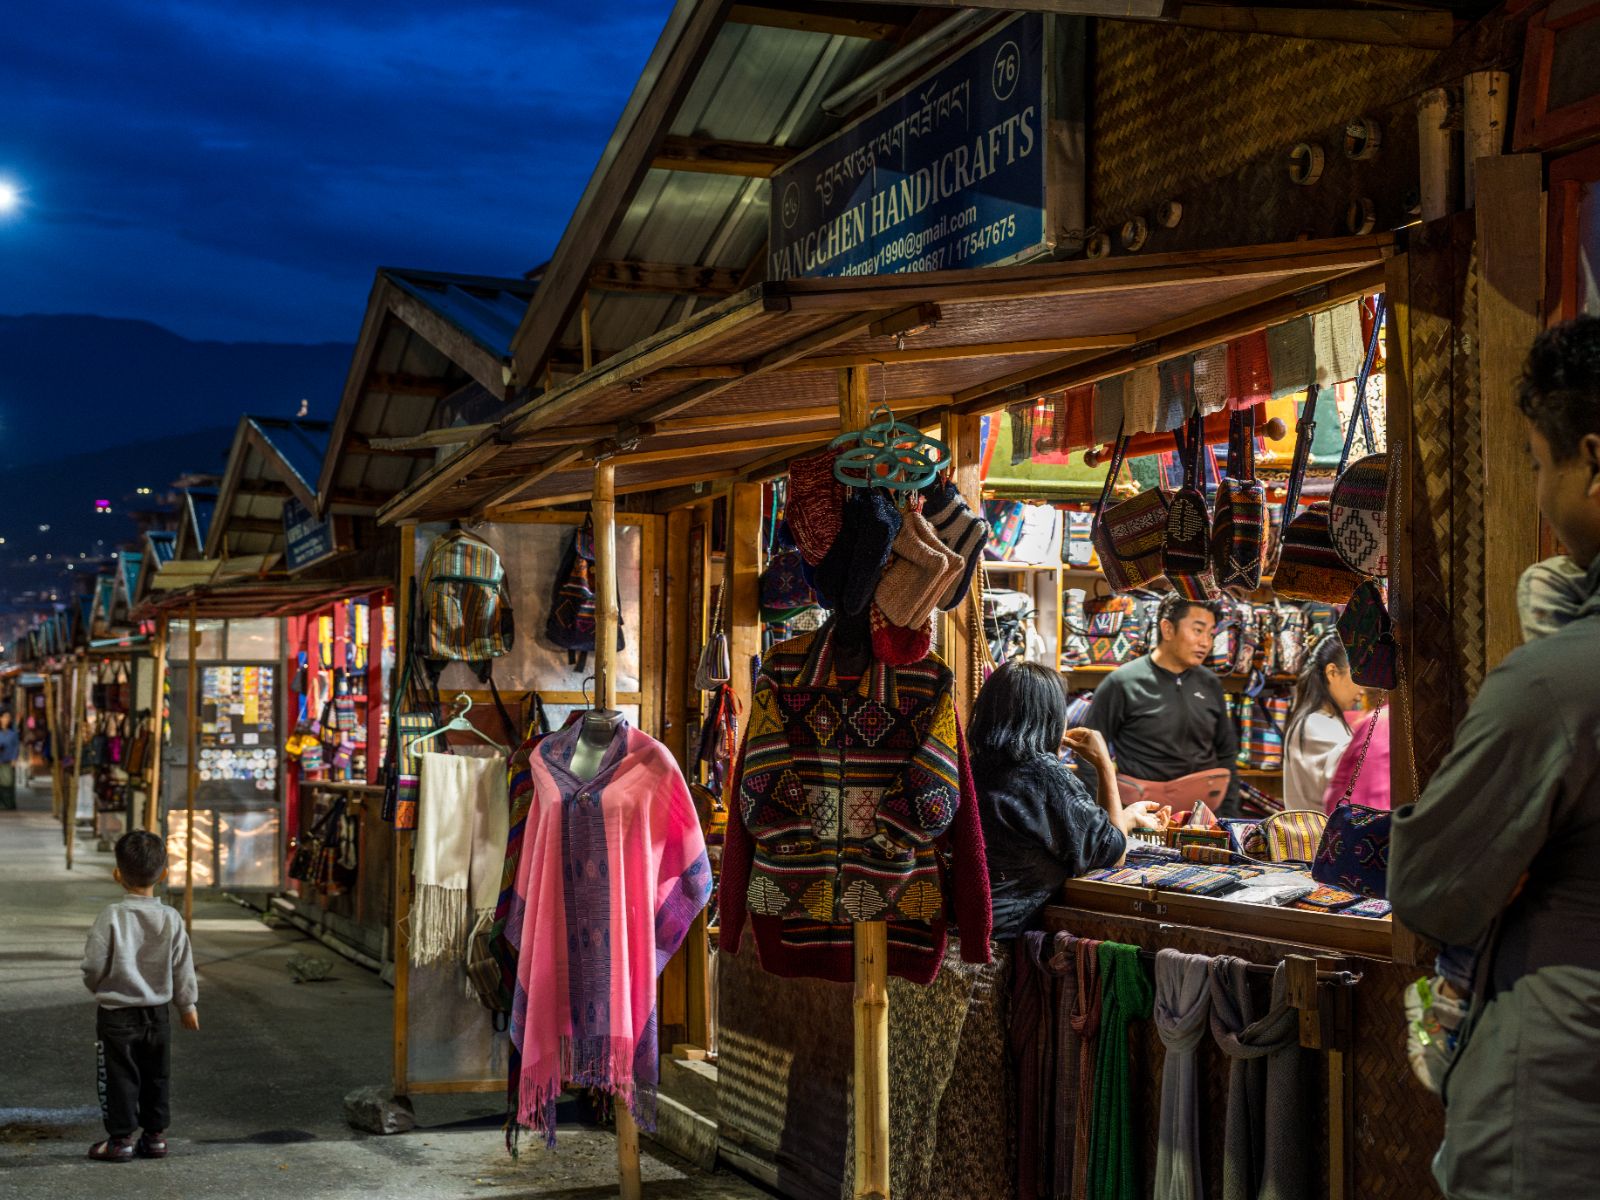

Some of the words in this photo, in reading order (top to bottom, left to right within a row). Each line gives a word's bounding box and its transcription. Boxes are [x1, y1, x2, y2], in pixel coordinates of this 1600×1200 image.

[997, 54, 1015, 88] 76
[772, 201, 866, 281] YANGCHEN
[870, 106, 1035, 238] HANDICRAFTS
[895, 246, 945, 274] 89687
[956, 214, 1016, 262] 17547675
